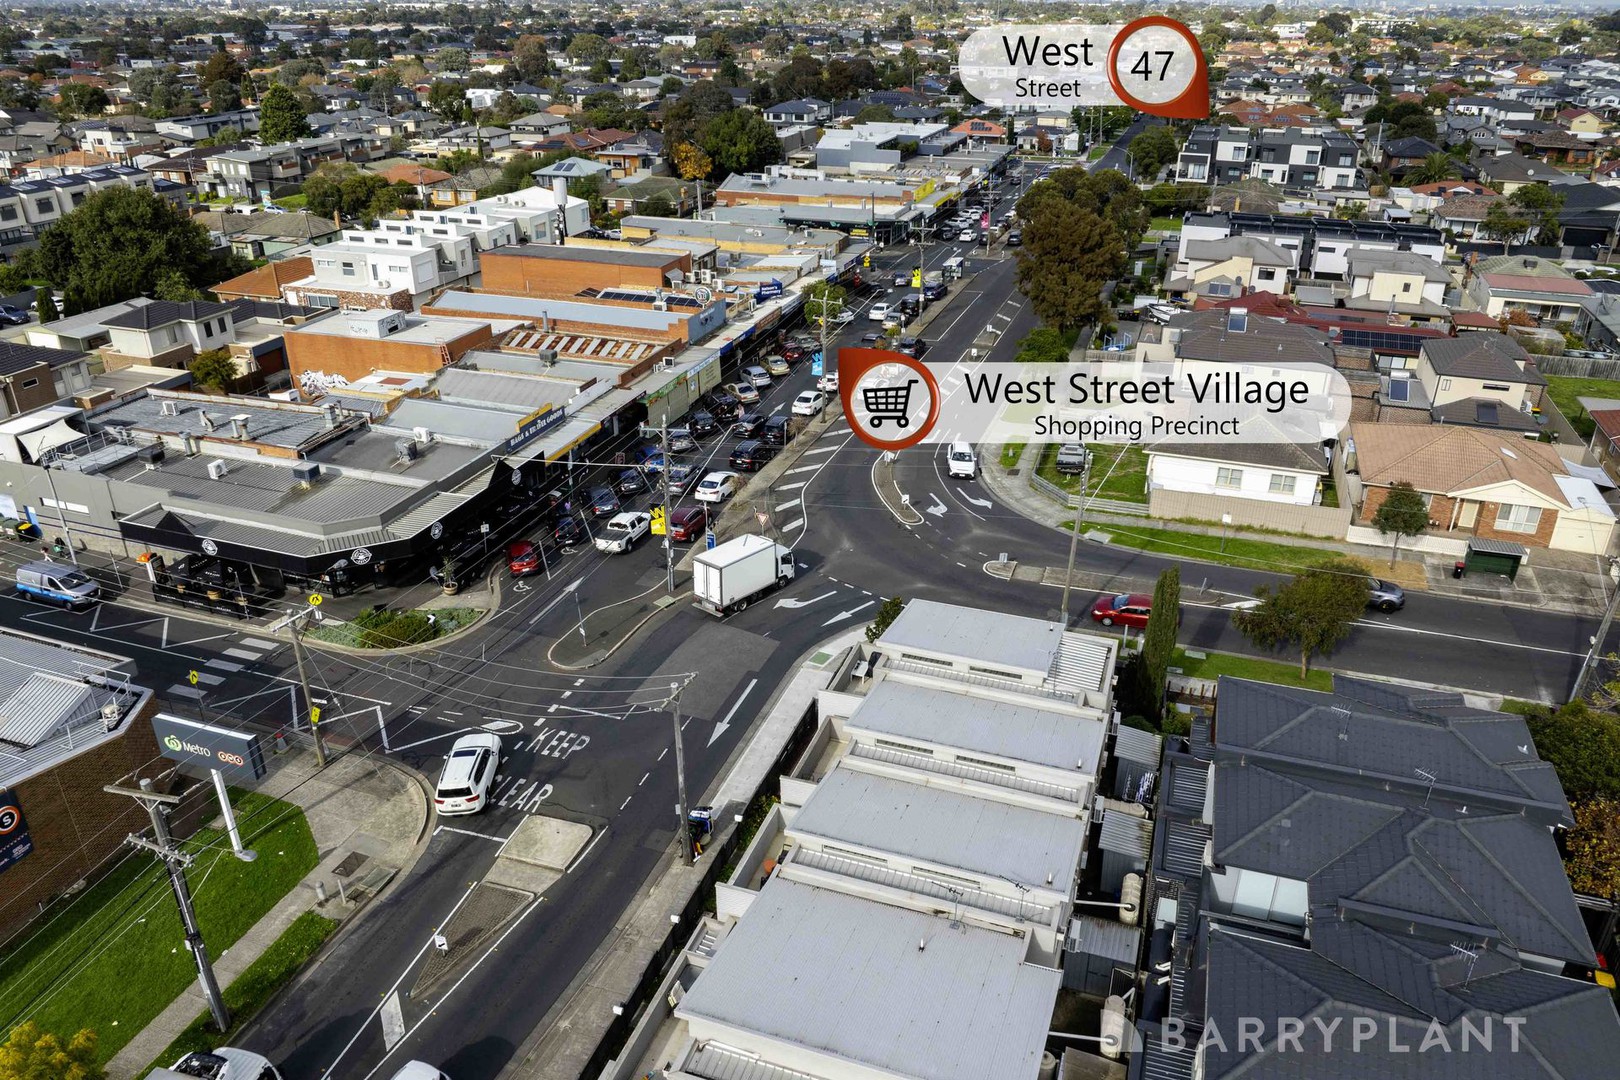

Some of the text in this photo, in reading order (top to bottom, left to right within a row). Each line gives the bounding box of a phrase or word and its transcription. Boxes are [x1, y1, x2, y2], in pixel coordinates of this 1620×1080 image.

[183, 741, 211, 757] Metro
[524, 727, 591, 760] KEEP
[490, 775, 554, 813] LEAR
